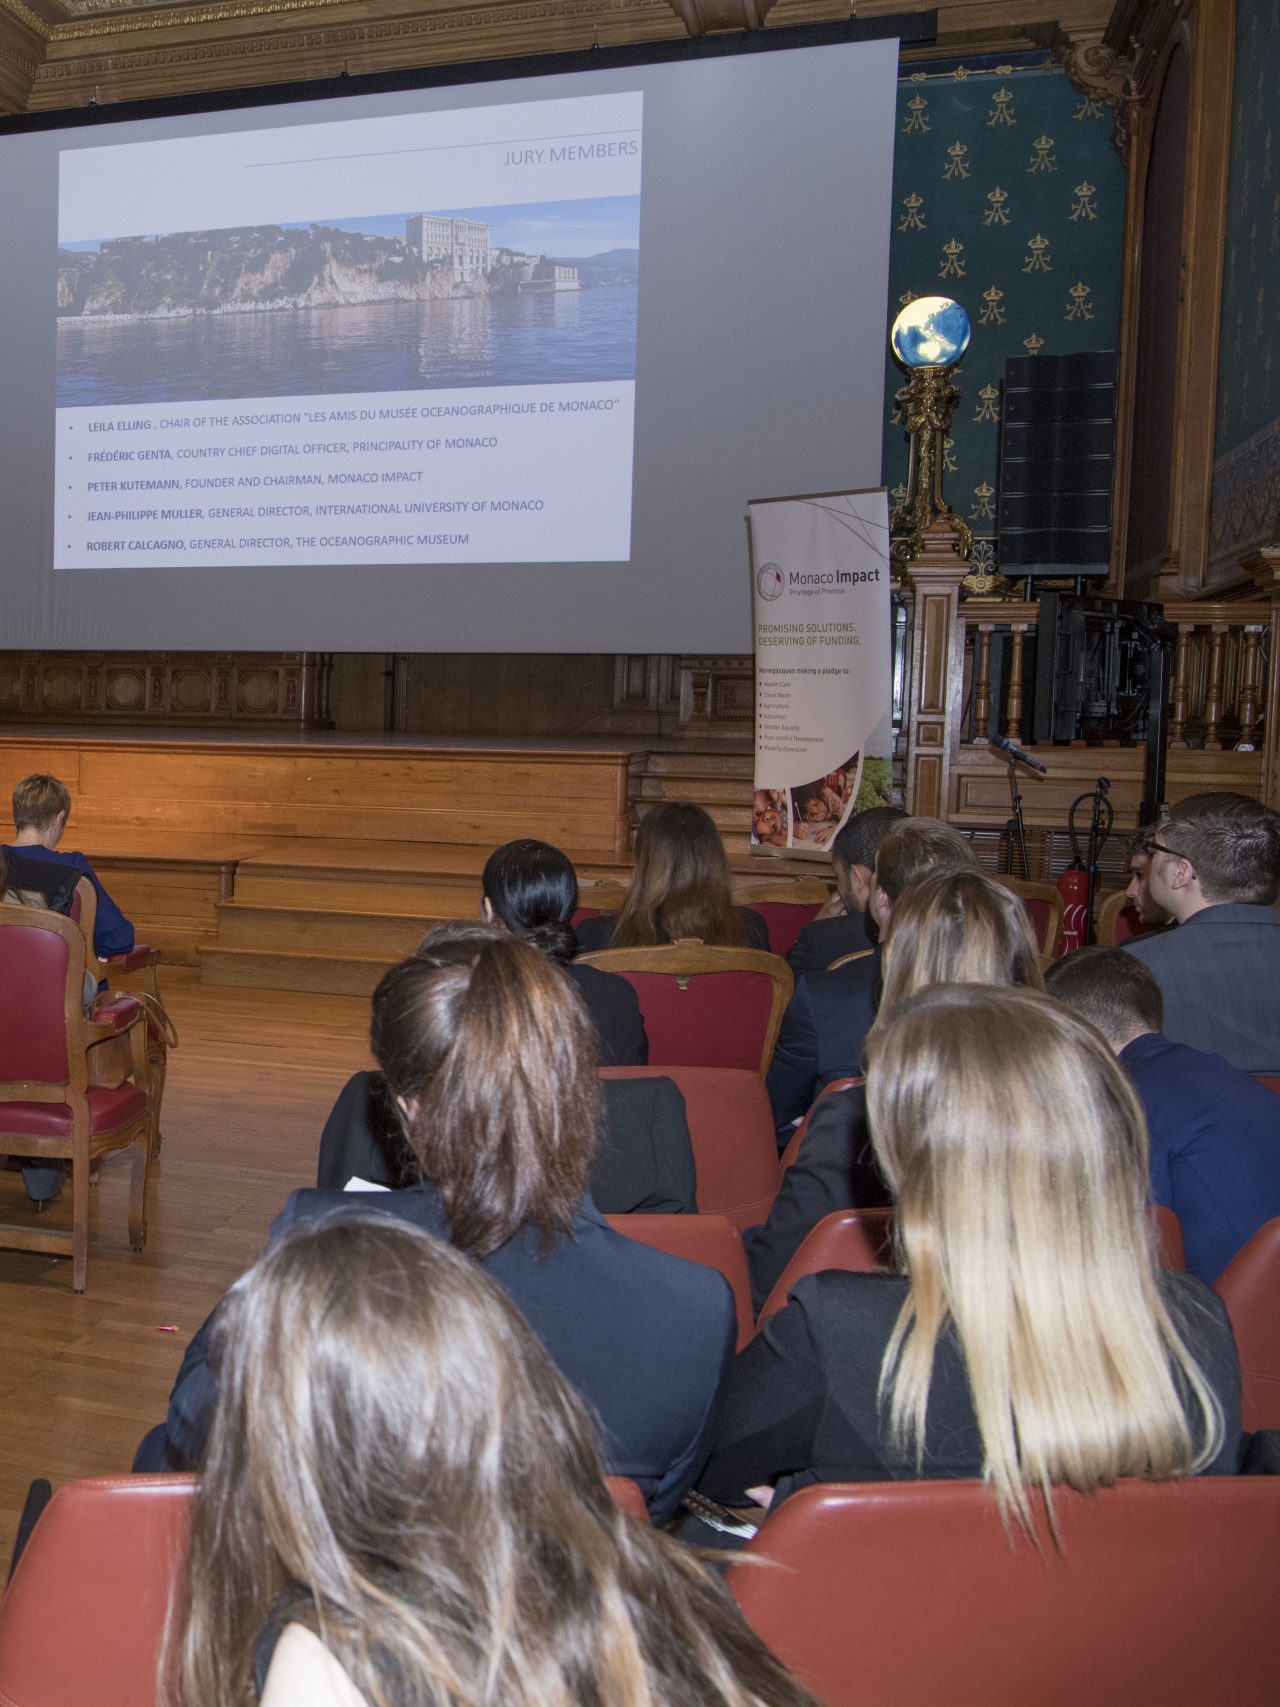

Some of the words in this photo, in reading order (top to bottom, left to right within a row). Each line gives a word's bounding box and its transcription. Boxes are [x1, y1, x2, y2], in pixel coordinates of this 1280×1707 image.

[504, 148, 544, 166] JURY
[550, 140, 639, 162] MEMBERS
[88, 422, 114, 432] LEILA
[117, 420, 151, 430] ELLING
[160, 419, 190, 428] CHAIR
[192, 418, 207, 427] OF
[209, 417, 229, 426] THE
[232, 414, 301, 425] ASSOCIATION
[304, 412, 327, 422] "LES
[329, 411, 357, 421] AMIS
[360, 410, 376, 420] DU
[421, 403, 537, 417] OCEANOGRAPHIQUE
[540, 402, 555, 412] DE
[558, 400, 620, 411] MONACO"
[88, 450, 135, 462] FRÉDÉRIC
[138, 450, 174, 460] GENTA,
[177, 448, 226, 458] COUNTRY
[228, 447, 258, 456] CHIEF
[260, 445, 300, 455] DIGITAL
[302, 443, 350, 453] OFFICER,
[352, 440, 423, 451] PRINCIPALITY
[426, 440, 442, 449] OF
[445, 438, 498, 448] MONACO
[88, 482, 118, 491] PETER
[120, 480, 182, 490] KUTEMANN,
[185, 478, 235, 488] FOUNDER
[238, 477, 261, 486] AND
[263, 475, 325, 485] CHAIRMAN,
[328, 473, 379, 483] MONACO
[382, 472, 423, 481] IMPACT
[87, 510, 158, 521] JEAN-PHILIPPE
[161, 509, 205, 519] MULLER,
[208, 508, 255, 518] GENERAL
[258, 506, 313, 516] DIRECTOR,
[315, 504, 402, 515] INTERNATIONAL
[404, 502, 469, 513] UNIVERSITY
[471, 502, 487, 511] OF
[490, 500, 544, 511] MONACO
[87, 541, 126, 551] ROBERT
[128, 540, 187, 550] CALCAGNO,
[189, 539, 237, 549] GENERAL
[239, 538, 293, 548] DIRECTOR,
[296, 537, 316, 546] THE
[319, 536, 414, 546] OCEANOGRAPHIC
[417, 534, 469, 544] MUSEUM
[789, 572, 833, 585] Monaco
[836, 569, 880, 586] Impact
[758, 624, 804, 634] PROMISING
[806, 622, 857, 633] SOLUTIONS.
[757, 636, 806, 647] DESERVING
[806, 635, 818, 646] OF
[819, 635, 862, 646] FUNDING.
[797, 667, 817, 675] making
[822, 667, 841, 675] pledge
